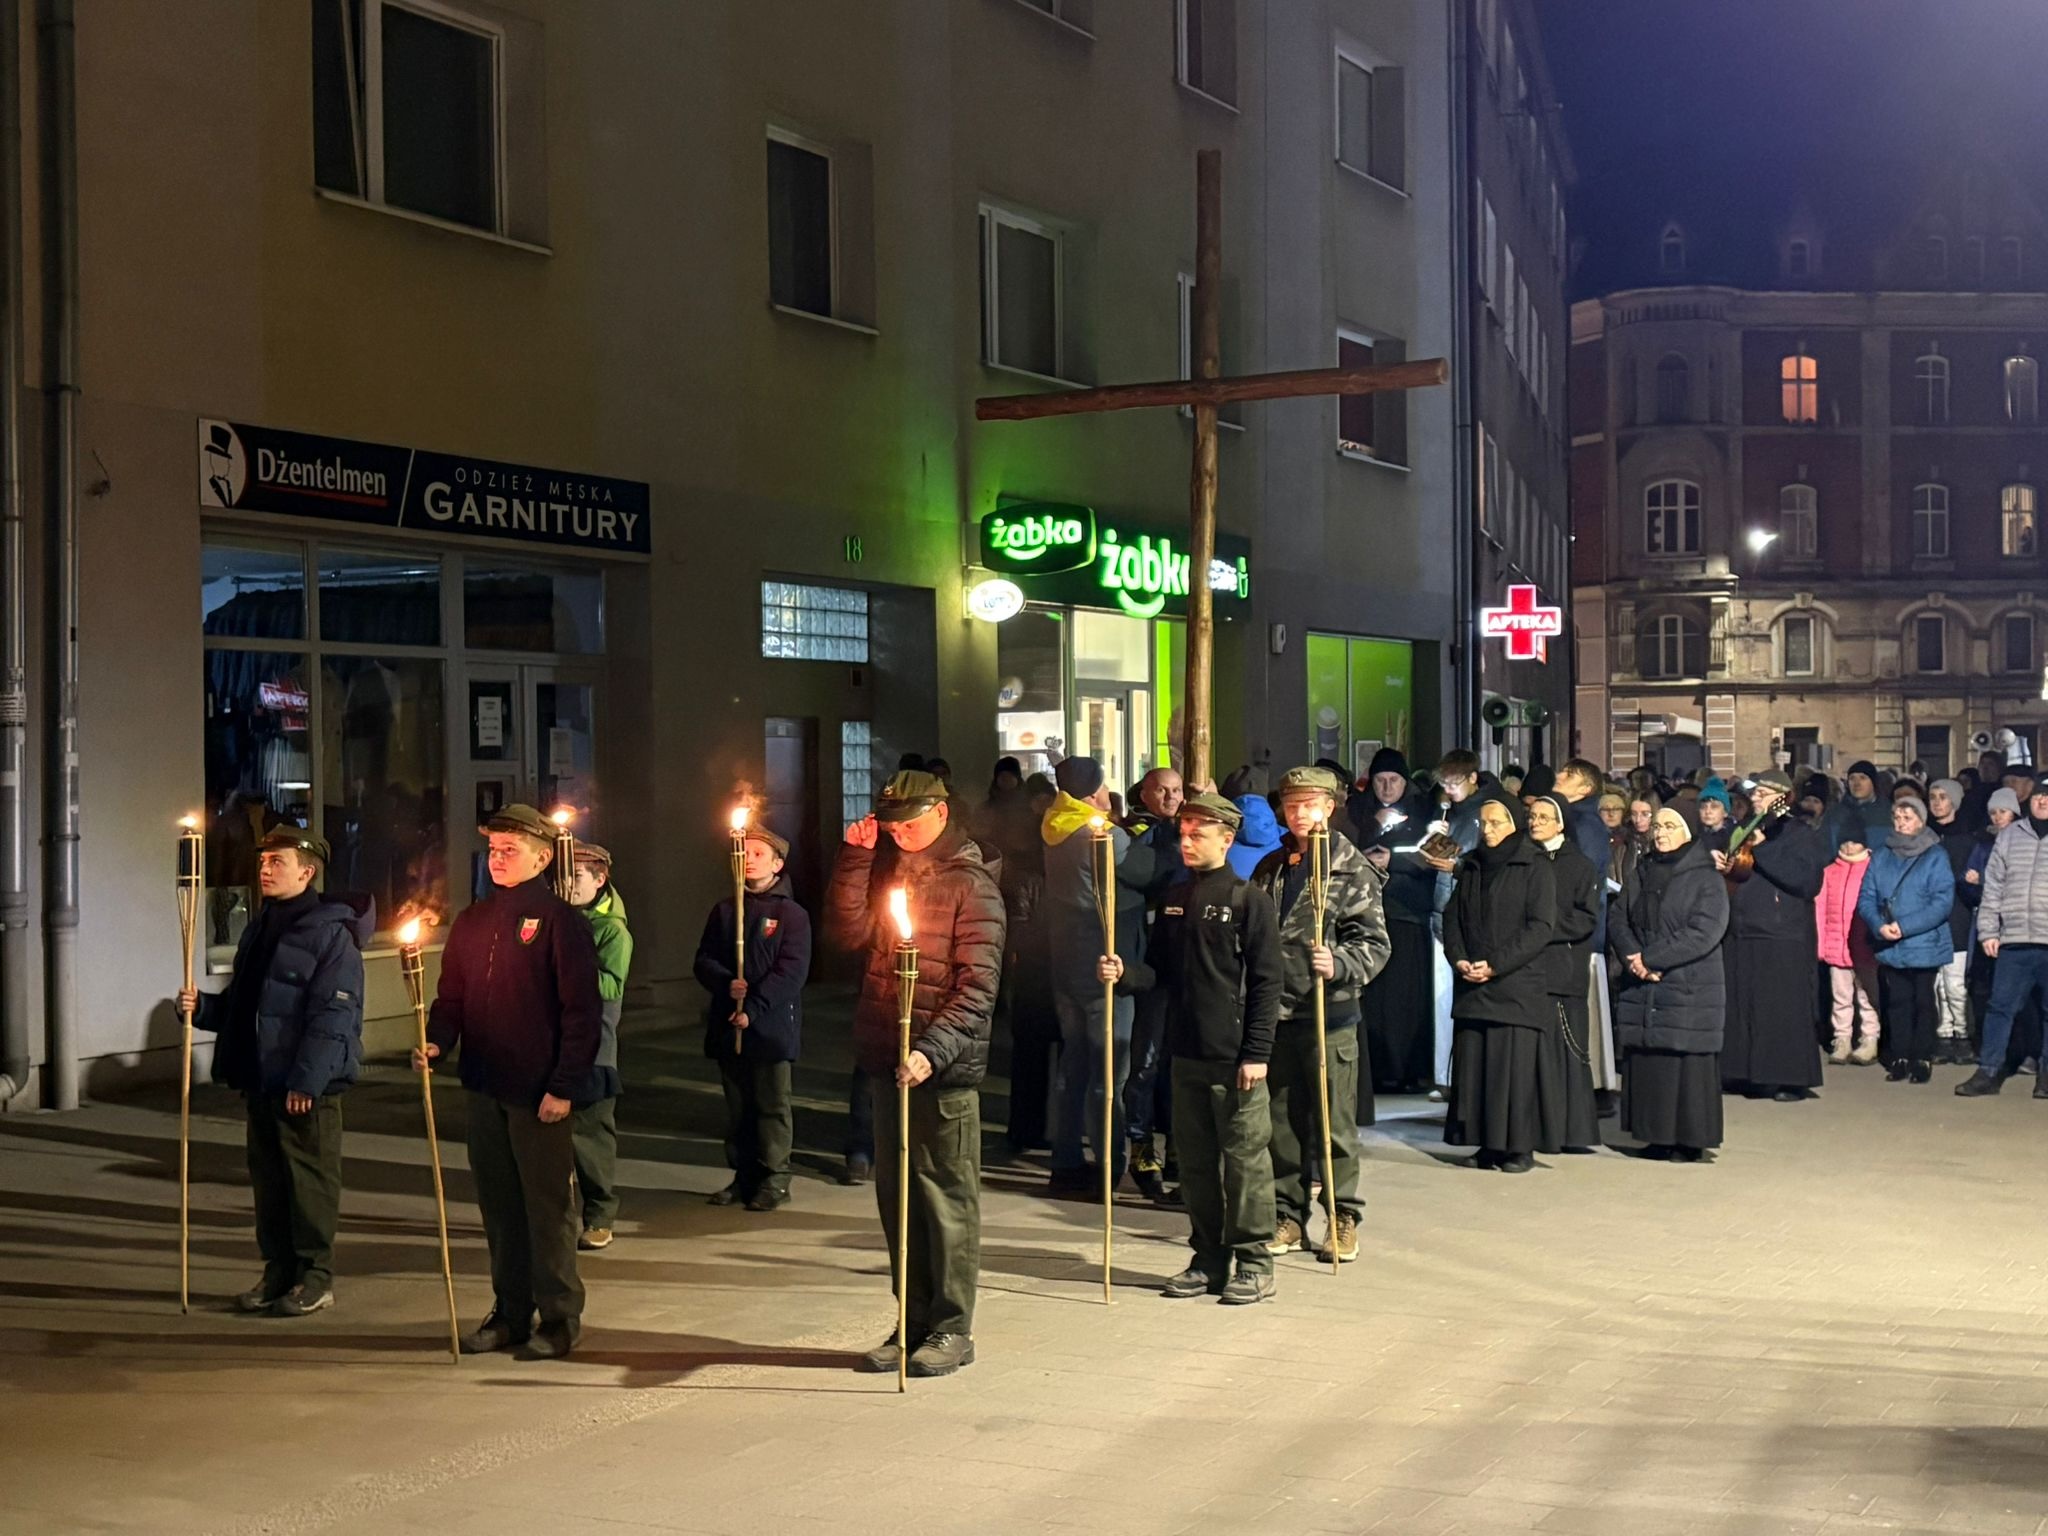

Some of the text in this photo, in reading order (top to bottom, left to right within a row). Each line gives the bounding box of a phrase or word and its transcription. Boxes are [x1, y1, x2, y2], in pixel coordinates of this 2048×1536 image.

[257, 448, 387, 496] Dżentelmen
[455, 467, 613, 503] ODZIEŻ MĘSKA
[423, 481, 639, 542] GARNITURY
[990, 515, 1083, 548] żabka
[845, 535, 863, 563] 18
[1488, 613, 1556, 630] APTEKA
